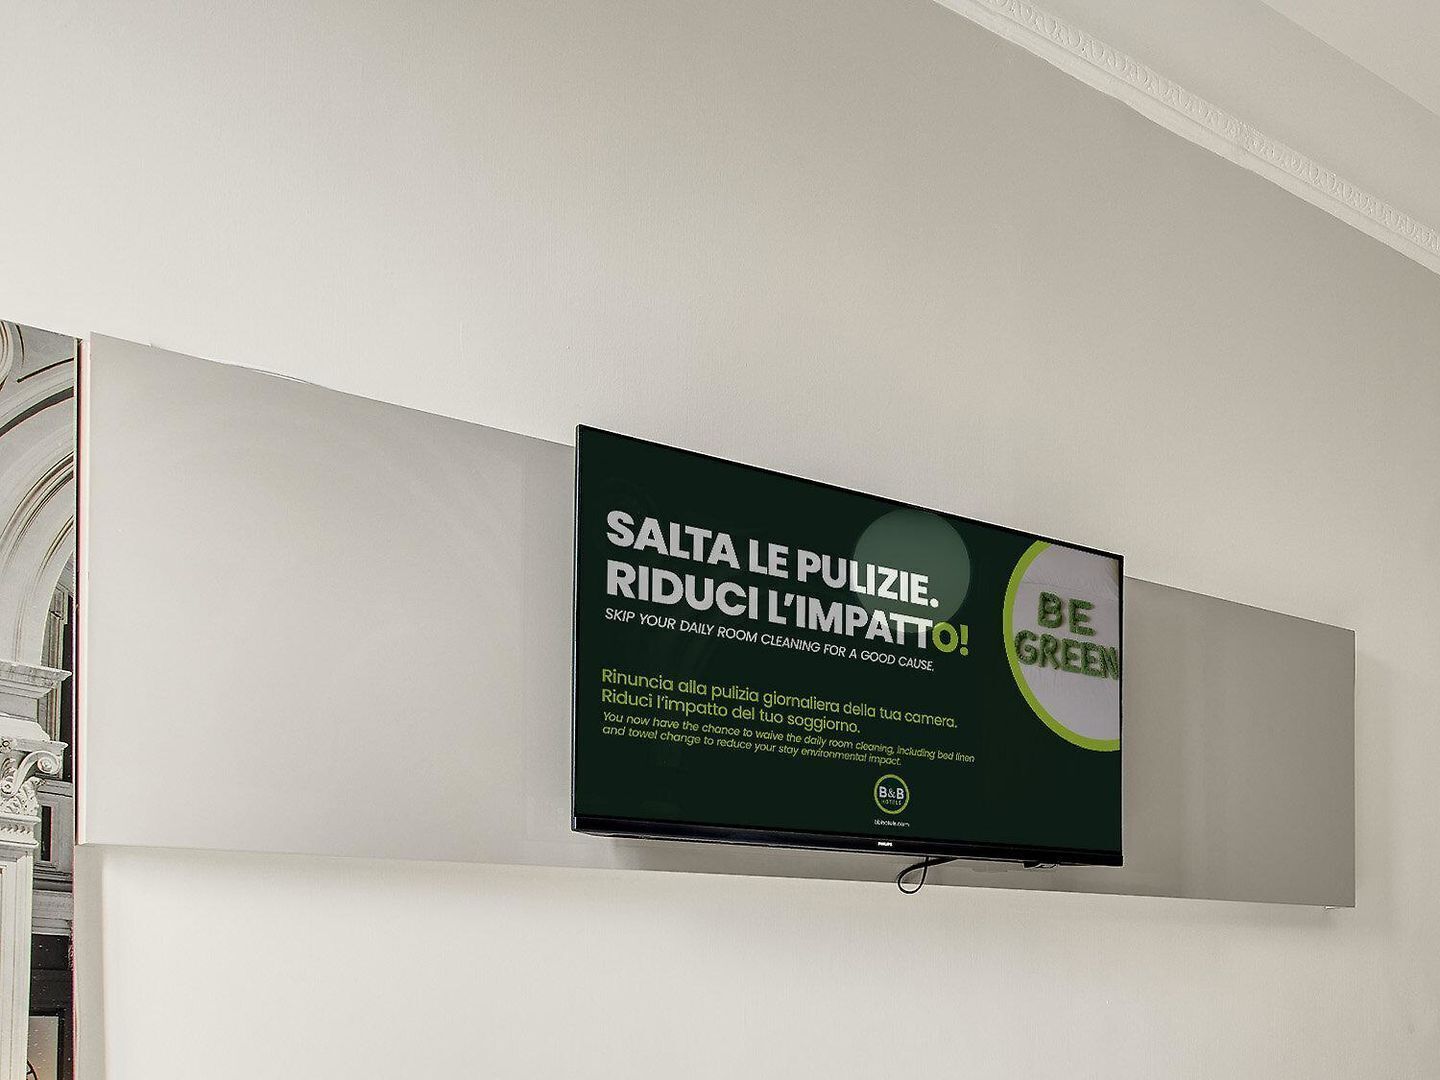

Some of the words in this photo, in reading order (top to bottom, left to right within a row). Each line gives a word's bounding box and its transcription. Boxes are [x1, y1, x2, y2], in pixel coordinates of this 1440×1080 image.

[606, 509, 740, 569] SALTA
[749, 538, 789, 579] LE
[797, 548, 939, 608] PULIZIE.
[606, 559, 758, 620] RIDUCI
[768, 589, 969, 656] L'IMPATTO!
[1037, 590, 1097, 636] BE
[604, 607, 636, 623] SKIP
[639, 613, 676, 630] YOUR
[679, 620, 715, 636] DAILY
[716, 626, 758, 643] ROOM
[760, 633, 821, 653] CLEANING
[823, 643, 846, 658] FOR
[848, 648, 857, 659] A
[860, 650, 896, 665] GOOD
[898, 656, 935, 672] CAUSE.
[1014, 629, 1119, 681] GREEN
[601, 668, 673, 691] Rinuncia
[678, 679, 707, 695] alla
[711, 684, 759, 702] pulizia
[763, 690, 840, 713] giornaliera
[843, 701, 876, 718] della
[879, 706, 901, 721] tua
[904, 711, 958, 729] camera.
[601, 688, 652, 708] Riduci
[657, 695, 728, 717] l'impatto
[731, 705, 755, 721] del
[759, 708, 783, 724] tuo
[787, 714, 861, 734] soggiorno.
[602, 725, 626, 736] and
[628, 727, 658, 739] towel
[659, 730, 701, 746] change
[703, 736, 714, 746] to
[716, 737, 752, 750] reduce
[754, 742, 777, 755] your
[778, 743, 800, 757] stay
[800, 747, 867, 763] environmental
[603, 711, 624, 723] You
[626, 714, 650, 726] now
[652, 716, 679, 729] have
[682, 720, 699, 731] the
[702, 723, 741, 736] chance
[742, 727, 753, 737] to
[755, 729, 784, 741] waive
[786, 733, 802, 743] the
[804, 735, 828, 747] daily
[828, 739, 853, 750] room
[896, 746, 935, 761] including
[937, 750, 954, 760] bed
[955, 752, 975, 763] linen
[878, 786, 905, 799] B&B
